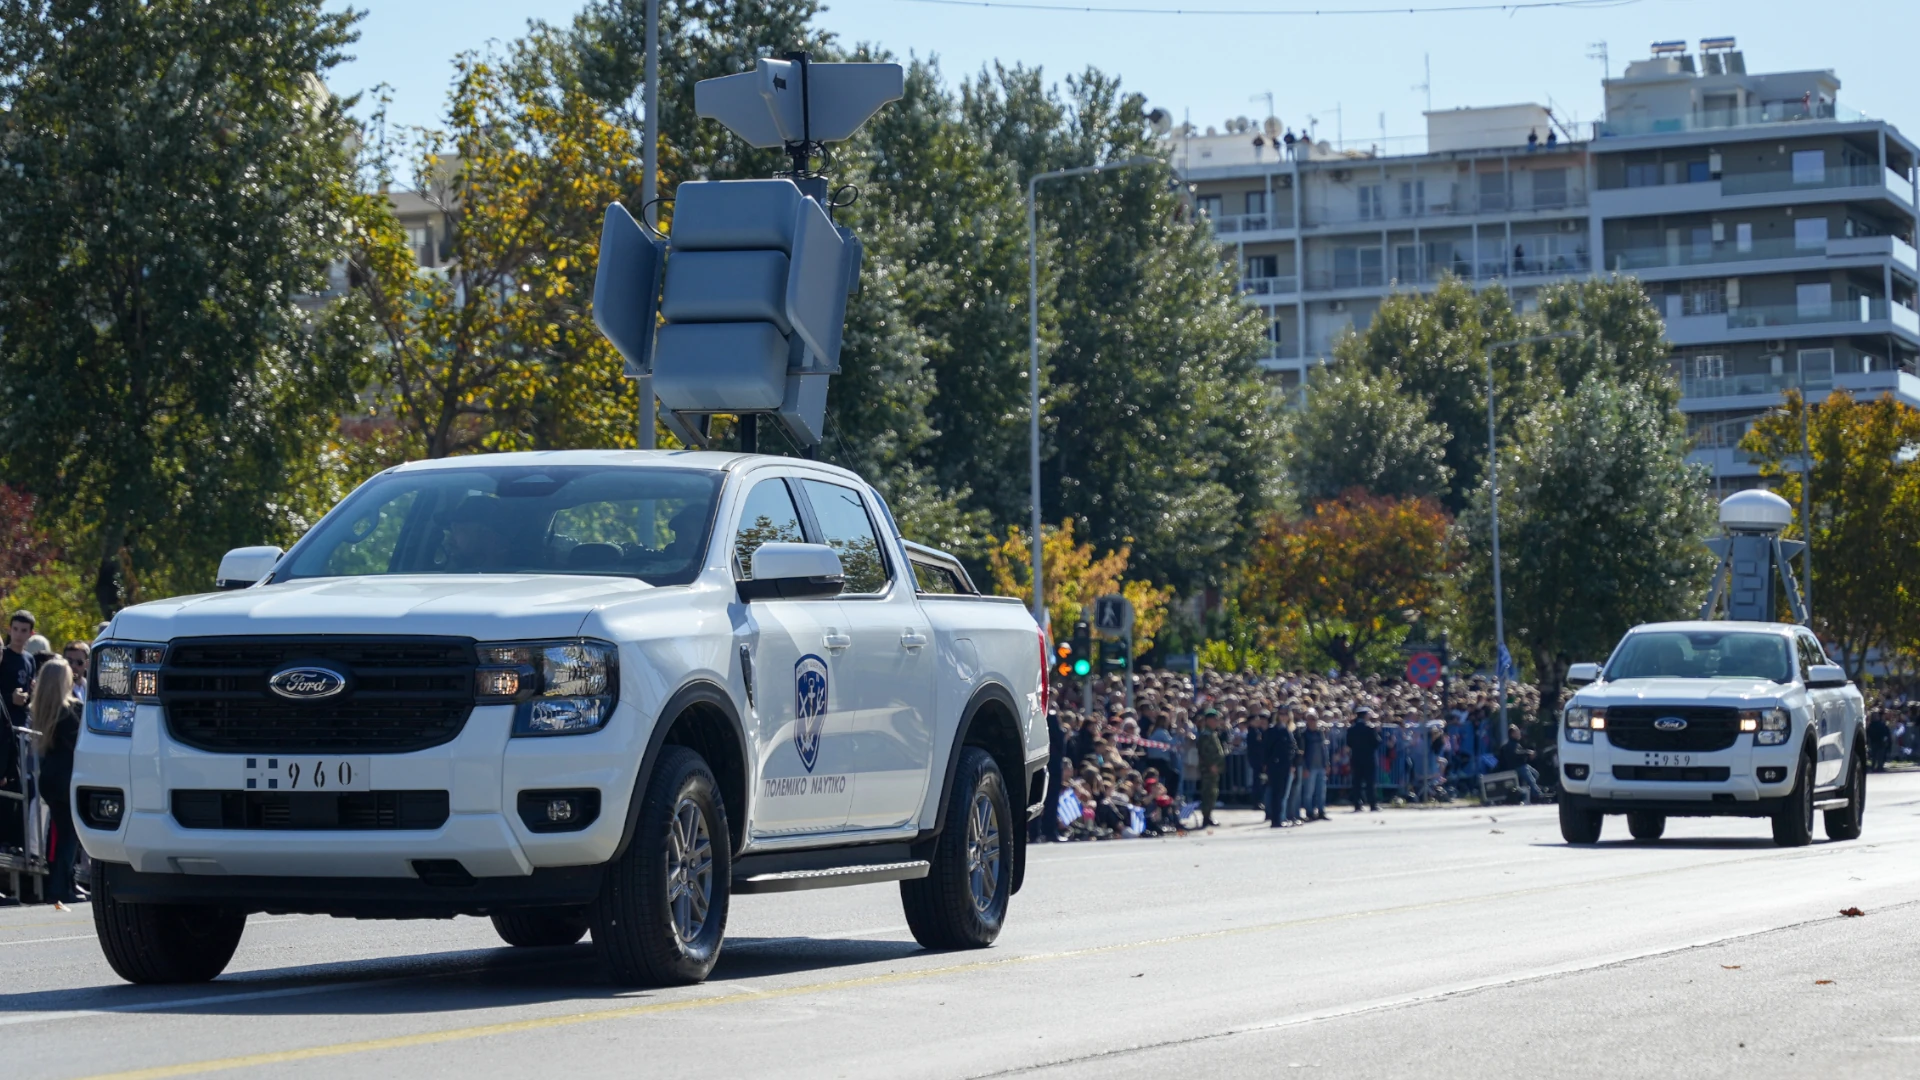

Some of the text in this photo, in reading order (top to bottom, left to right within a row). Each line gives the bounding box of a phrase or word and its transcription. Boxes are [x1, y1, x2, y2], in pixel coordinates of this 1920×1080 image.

[286, 673, 327, 691] Ford
[1662, 754, 1690, 766] 959
[288, 761, 352, 789] 960
[764, 775, 846, 798] ΠΟΛΕΜΙΚΟ ΝΑΥΤΙΚΟ
